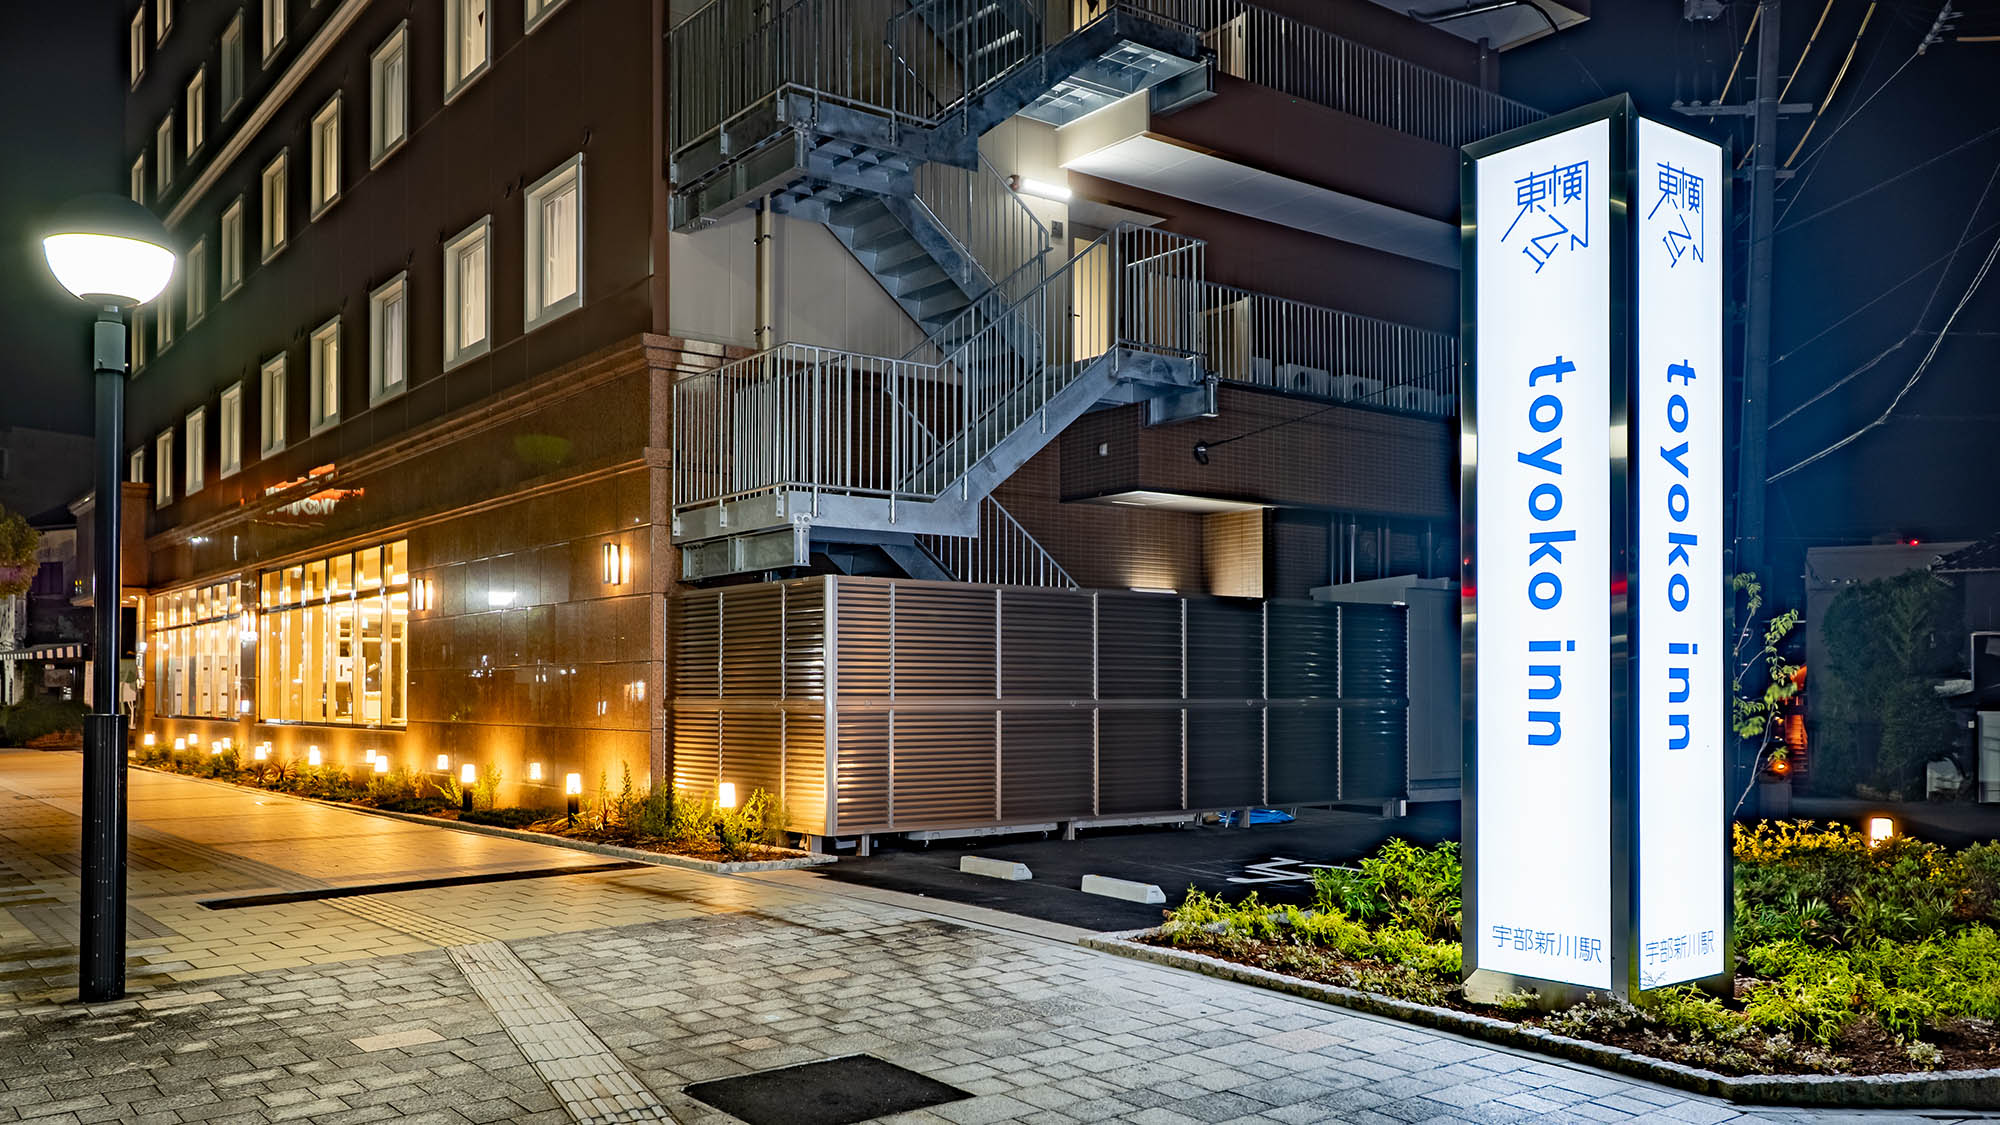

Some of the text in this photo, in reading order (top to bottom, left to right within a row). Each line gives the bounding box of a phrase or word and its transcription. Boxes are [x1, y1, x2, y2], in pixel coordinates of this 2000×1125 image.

[1517, 355, 1577, 747] toyoko inn
[1660, 359, 1698, 750] toyoko inn
[1491, 924, 1602, 964] 宇部新川駅
[1645, 929, 1715, 966] 宇部新川駅
